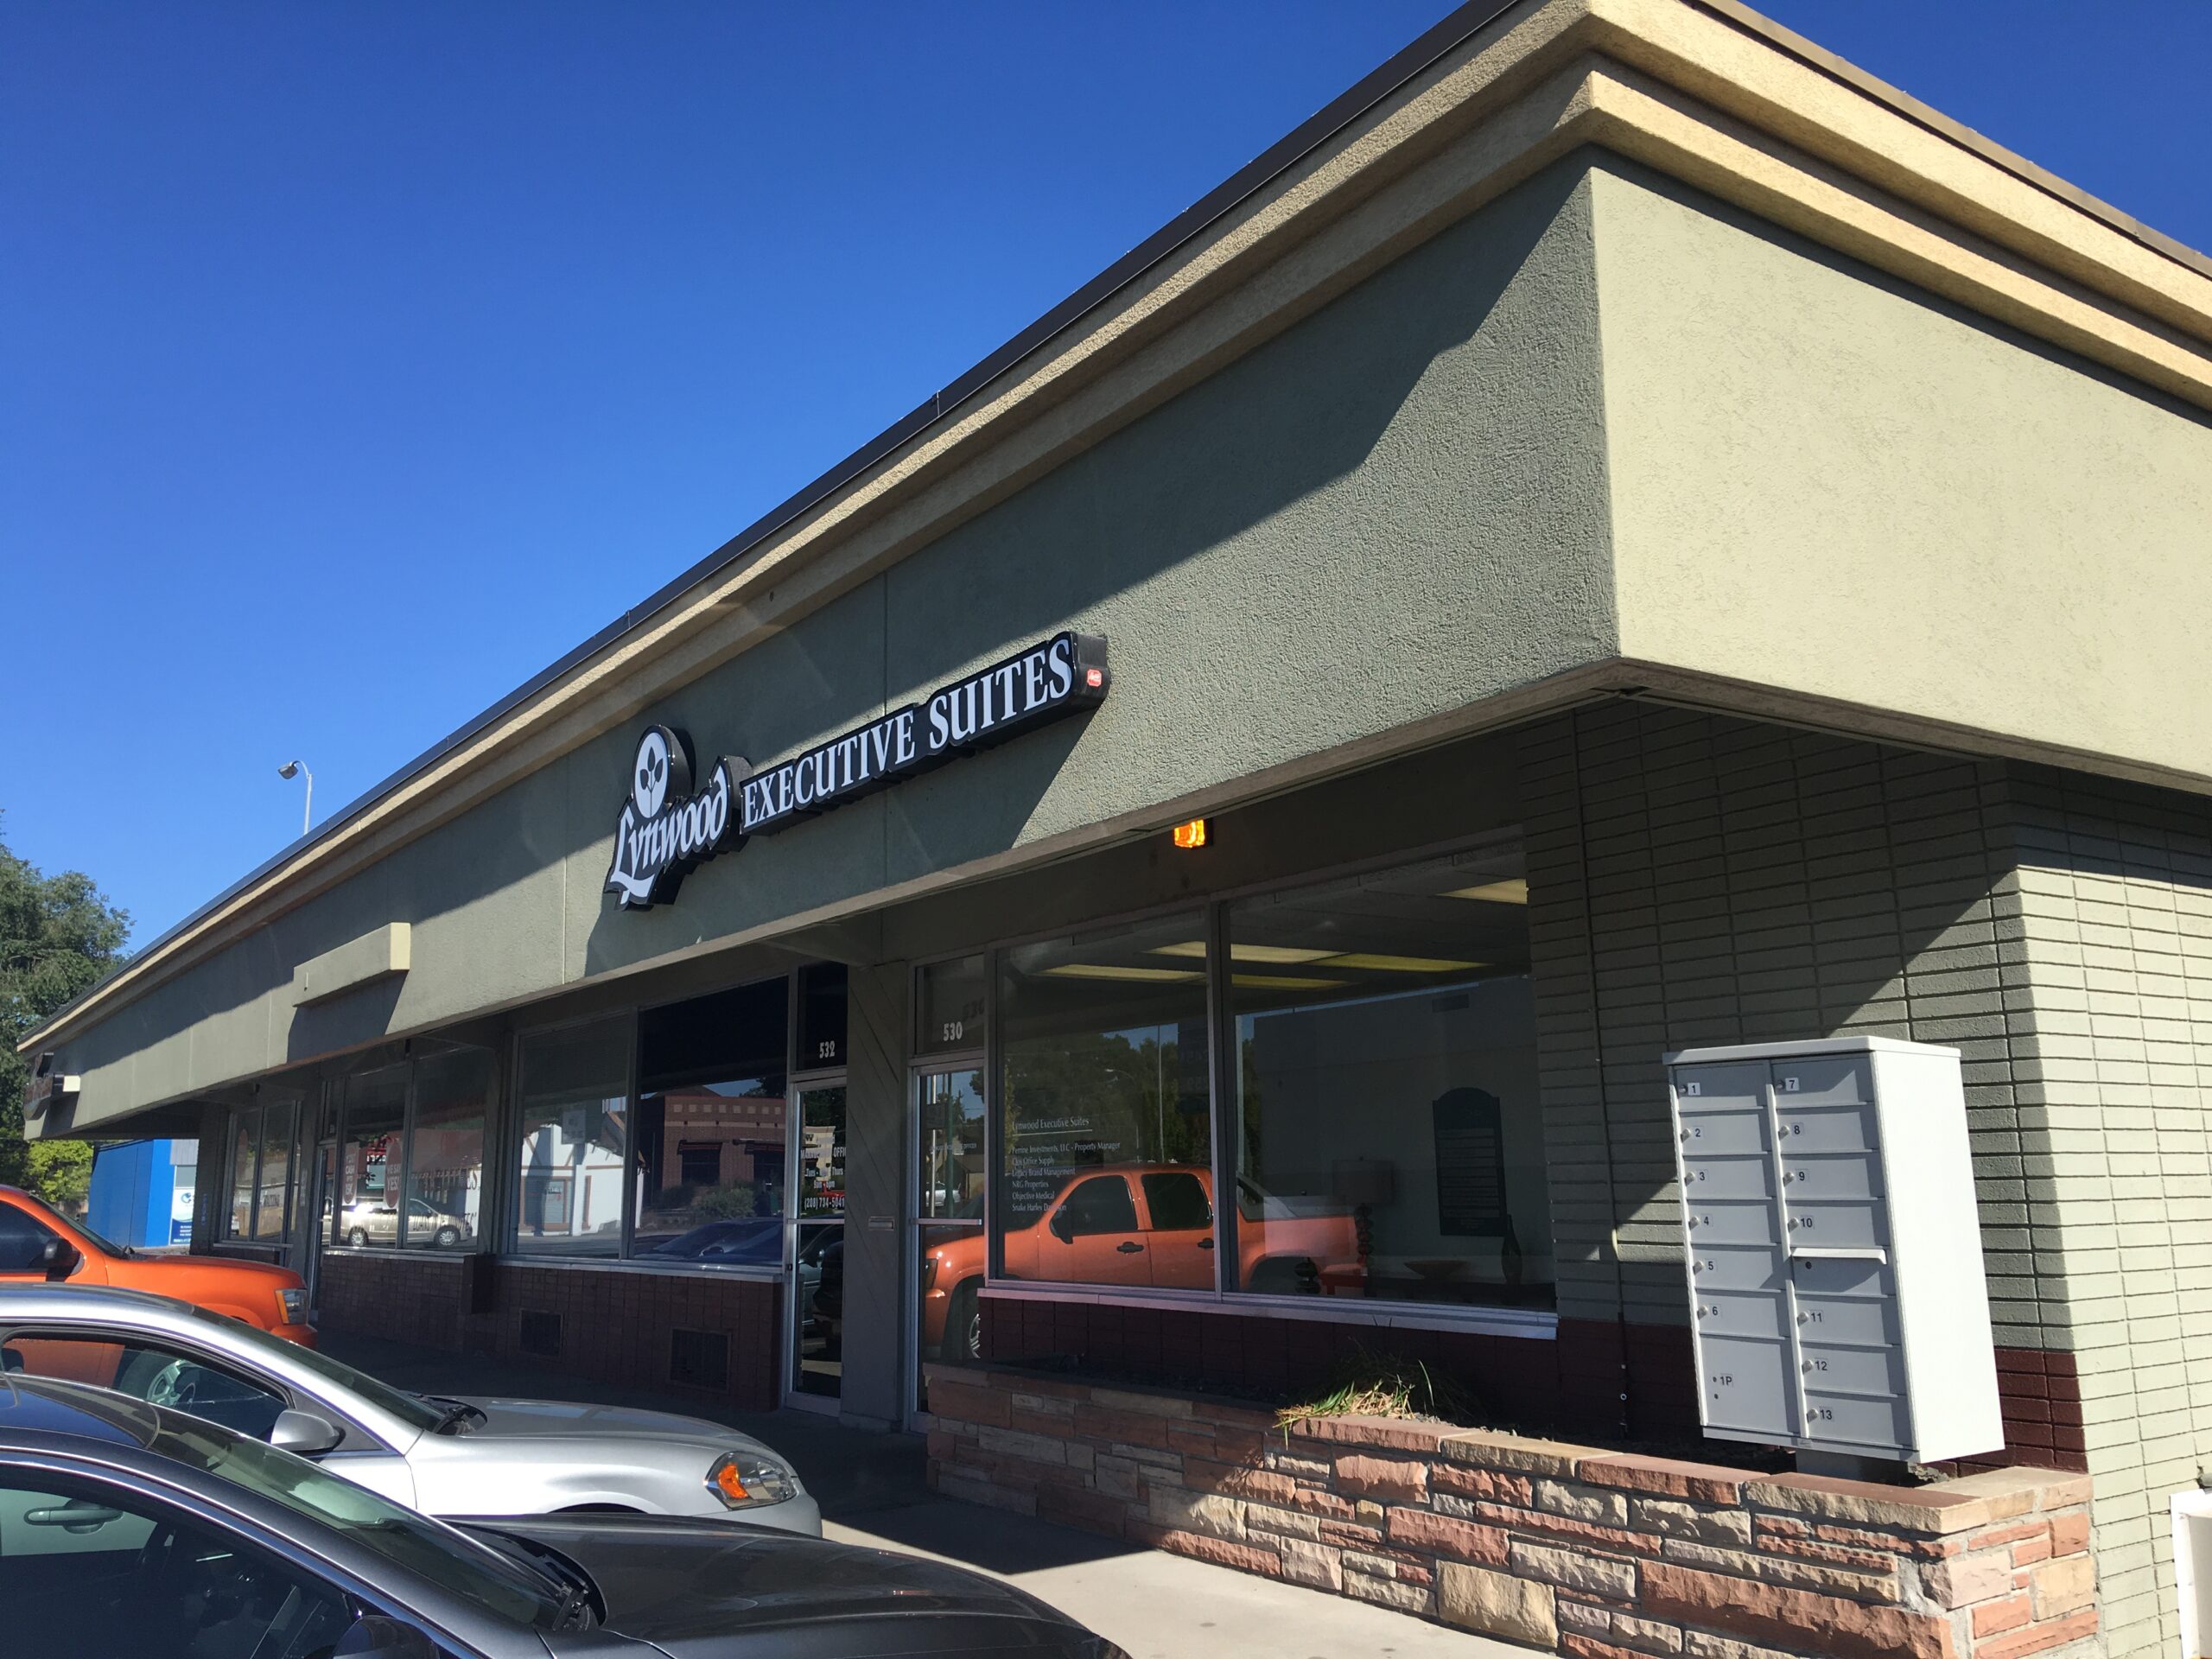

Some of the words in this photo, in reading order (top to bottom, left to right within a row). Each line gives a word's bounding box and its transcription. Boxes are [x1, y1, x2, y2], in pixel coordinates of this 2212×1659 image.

[610, 766, 728, 905] Lynwood
[742, 709, 916, 830] EXECUTIVE
[929, 638, 1072, 751] SUITES
[943, 1021, 963, 1041] 530
[819, 1039, 836, 1058] 532
[1692, 1084, 1696, 1094] 1
[1789, 1079, 1796, 1089] 7
[1039, 1117, 1069, 1128] Executive
[1070, 1116, 1090, 1127] Suites
[1694, 1128, 1701, 1138] 2
[1794, 1125, 1801, 1135] 8
[1699, 1171, 1706, 1181] 3
[1798, 1171, 1805, 1181] 9
[1703, 1216, 1709, 1226] 4
[1800, 1217, 1813, 1228] 10
[1707, 1261, 1714, 1271] 5
[1712, 1306, 1719, 1316] 6
[1810, 1313, 1822, 1322] 11
[1815, 1360, 1827, 1371] 12
[1719, 1376, 1732, 1386] 1P
[1820, 1409, 1833, 1421] 13
